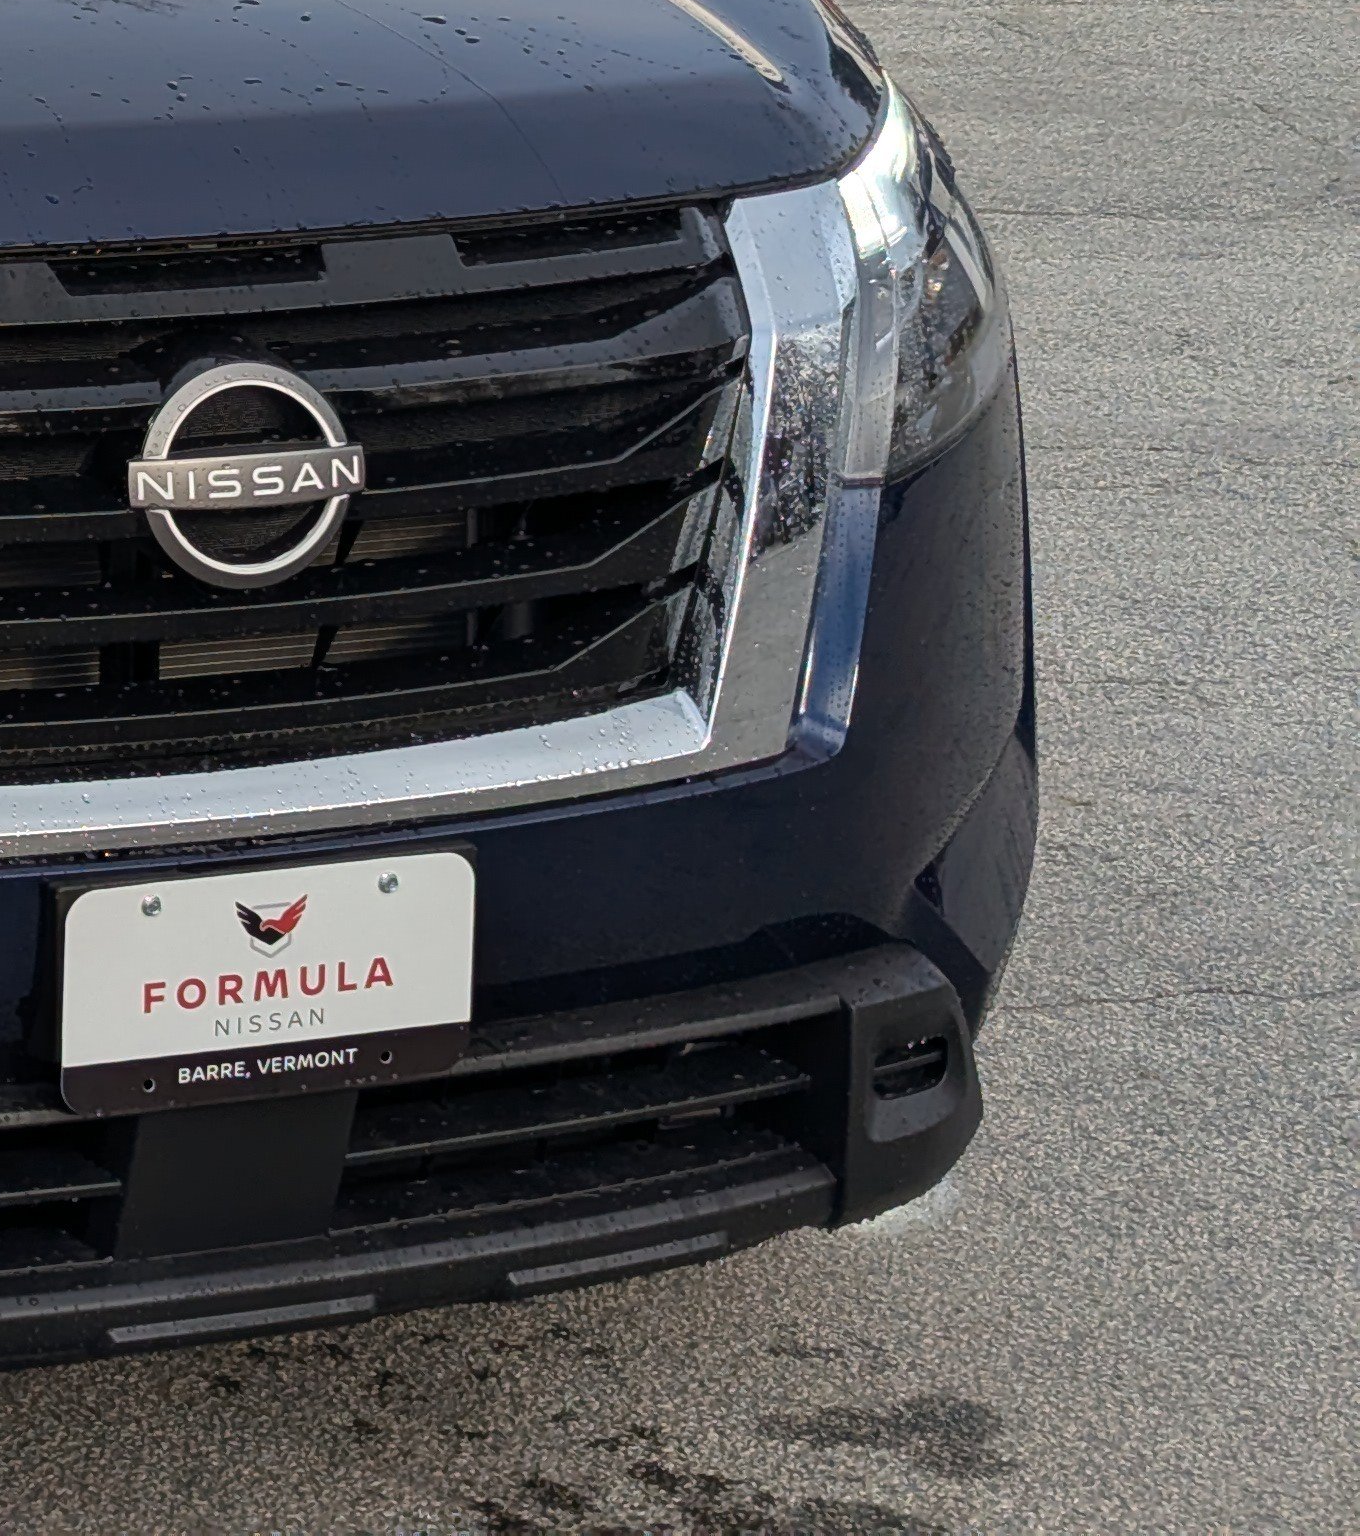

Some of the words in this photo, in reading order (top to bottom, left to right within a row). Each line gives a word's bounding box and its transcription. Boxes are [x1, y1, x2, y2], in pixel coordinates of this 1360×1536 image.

[136, 455, 360, 501] NISSAN
[142, 956, 395, 1015] FORMULA
[213, 1007, 326, 1038] NISSAN
[177, 1059, 252, 1085] BARRE,
[256, 1047, 359, 1076] VERMONT
